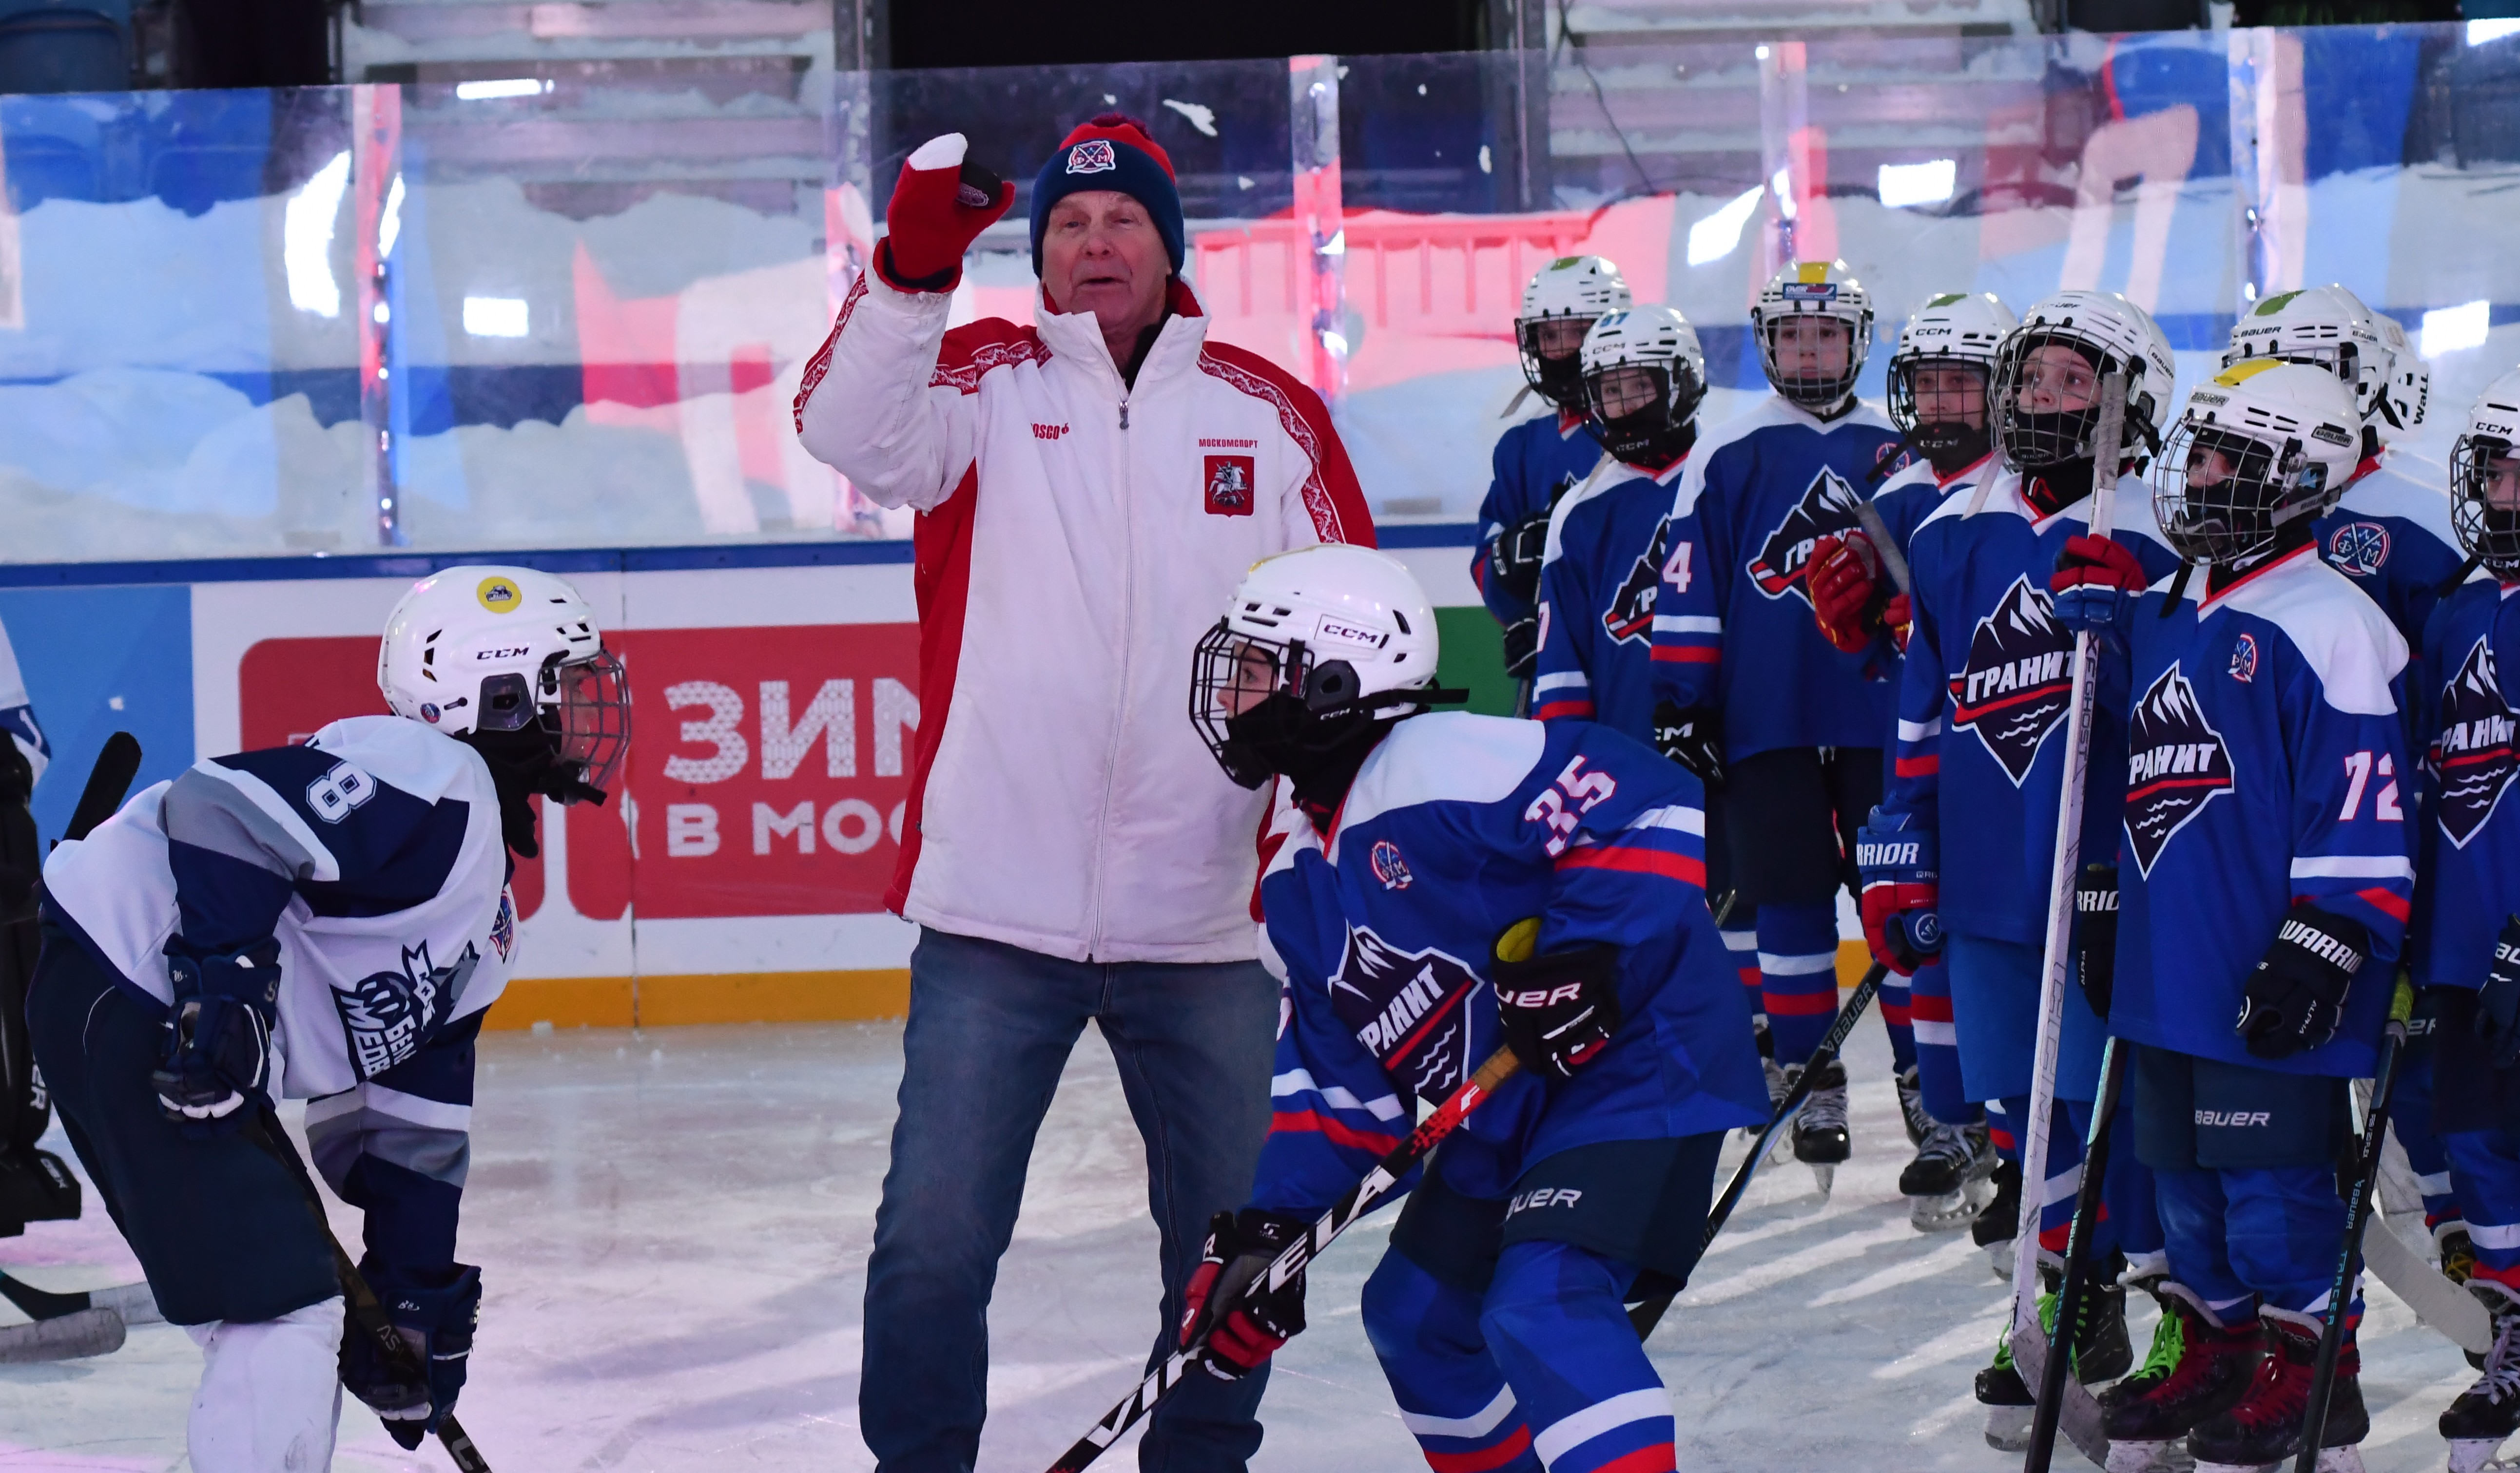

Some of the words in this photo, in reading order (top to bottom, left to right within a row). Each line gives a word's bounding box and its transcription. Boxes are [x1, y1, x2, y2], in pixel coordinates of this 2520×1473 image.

[1592, 343, 1626, 355] CCM
[1916, 328, 1952, 336] CCM
[1031, 422, 1060, 440] OSCO
[1199, 438, 1259, 449] МОСКОМСПОРТ
[2475, 421, 2513, 435] CCM
[1662, 541, 1693, 594] 4
[477, 647, 530, 660] CCM
[1324, 624, 1378, 643] CCM
[2441, 714, 2516, 758] РАНИТ
[2129, 743, 2218, 785] РАНИТ
[306, 759, 378, 825] 8
[1524, 754, 1618, 858] 35
[2338, 750, 2404, 822] 72
[666, 803, 721, 858] В
[1356, 962, 1444, 1058] РАНИТ
